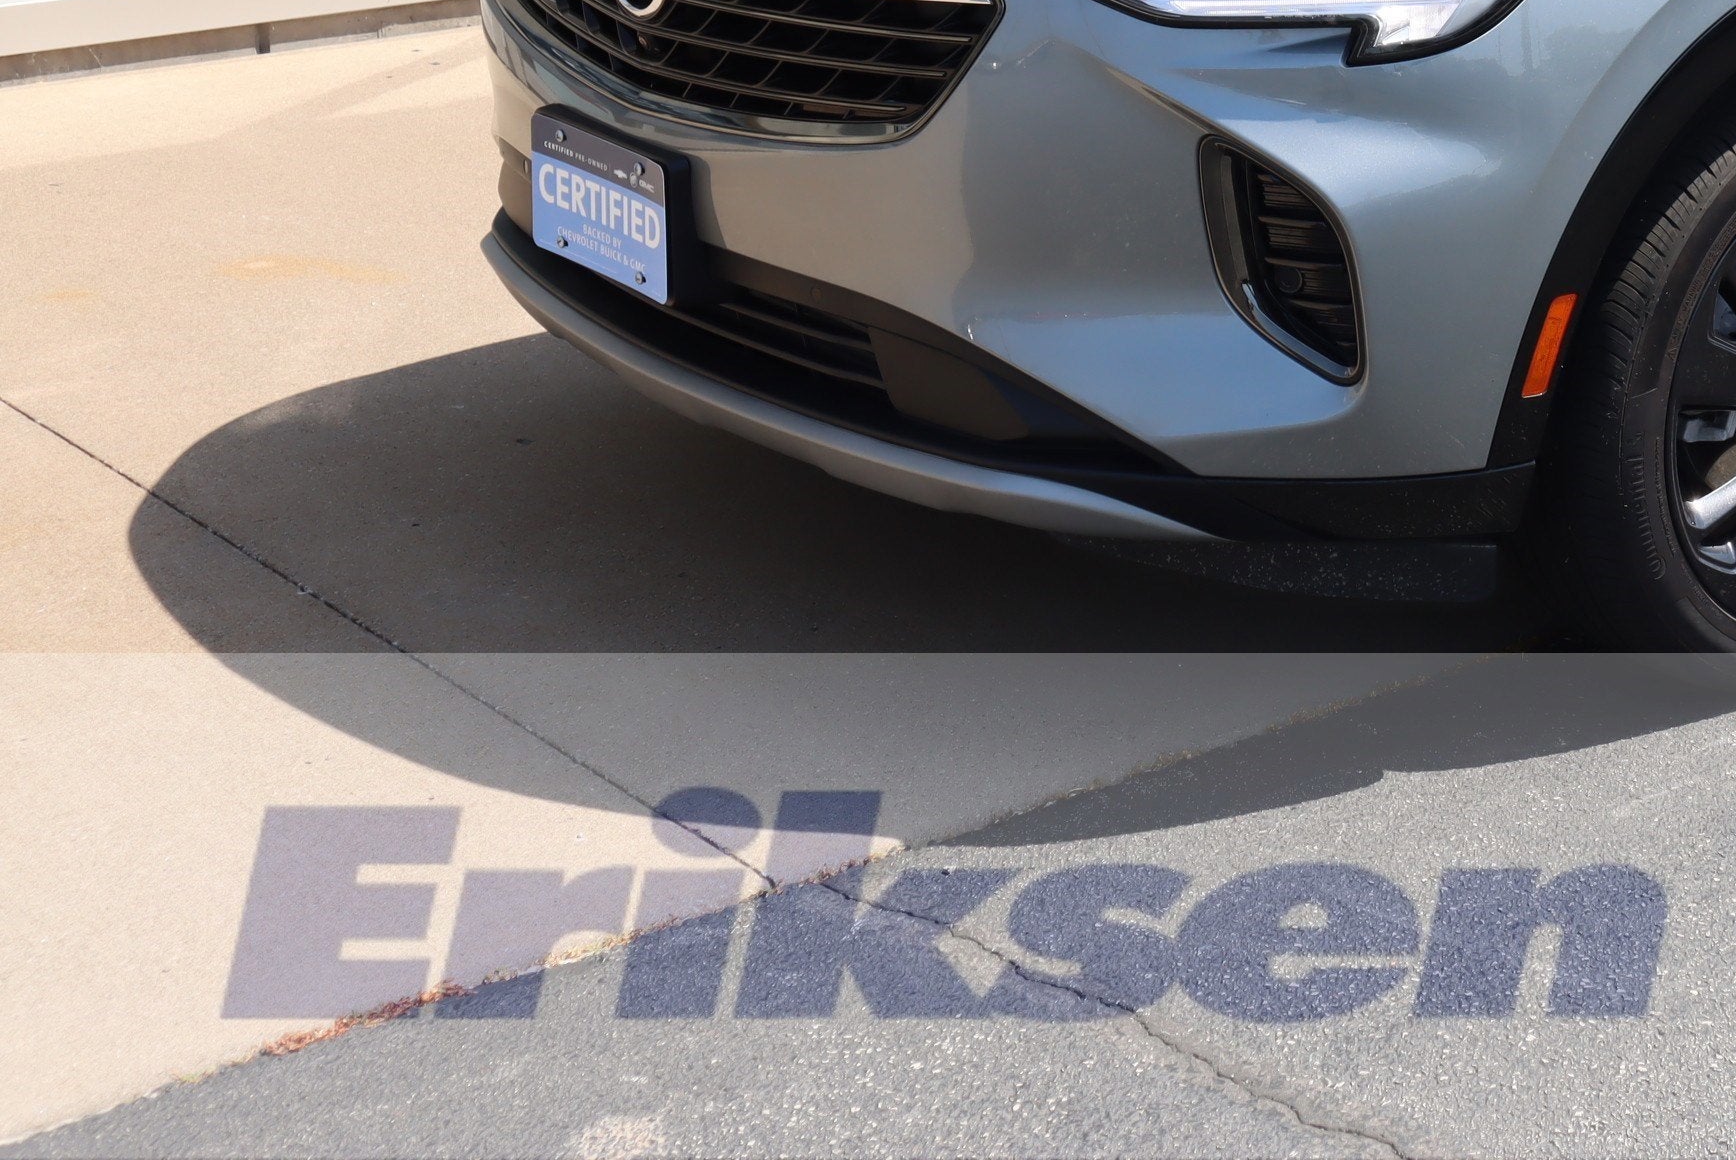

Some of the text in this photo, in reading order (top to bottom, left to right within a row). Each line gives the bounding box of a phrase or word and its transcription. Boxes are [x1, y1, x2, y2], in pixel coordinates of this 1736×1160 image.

[543, 140, 608, 172] CERTIFIED PRE-OWNED
[538, 163, 661, 249] CERTIFIED
[557, 226, 646, 272] CHEVROLET BUICK & GMC
[582, 224, 622, 250] BACKED BY
